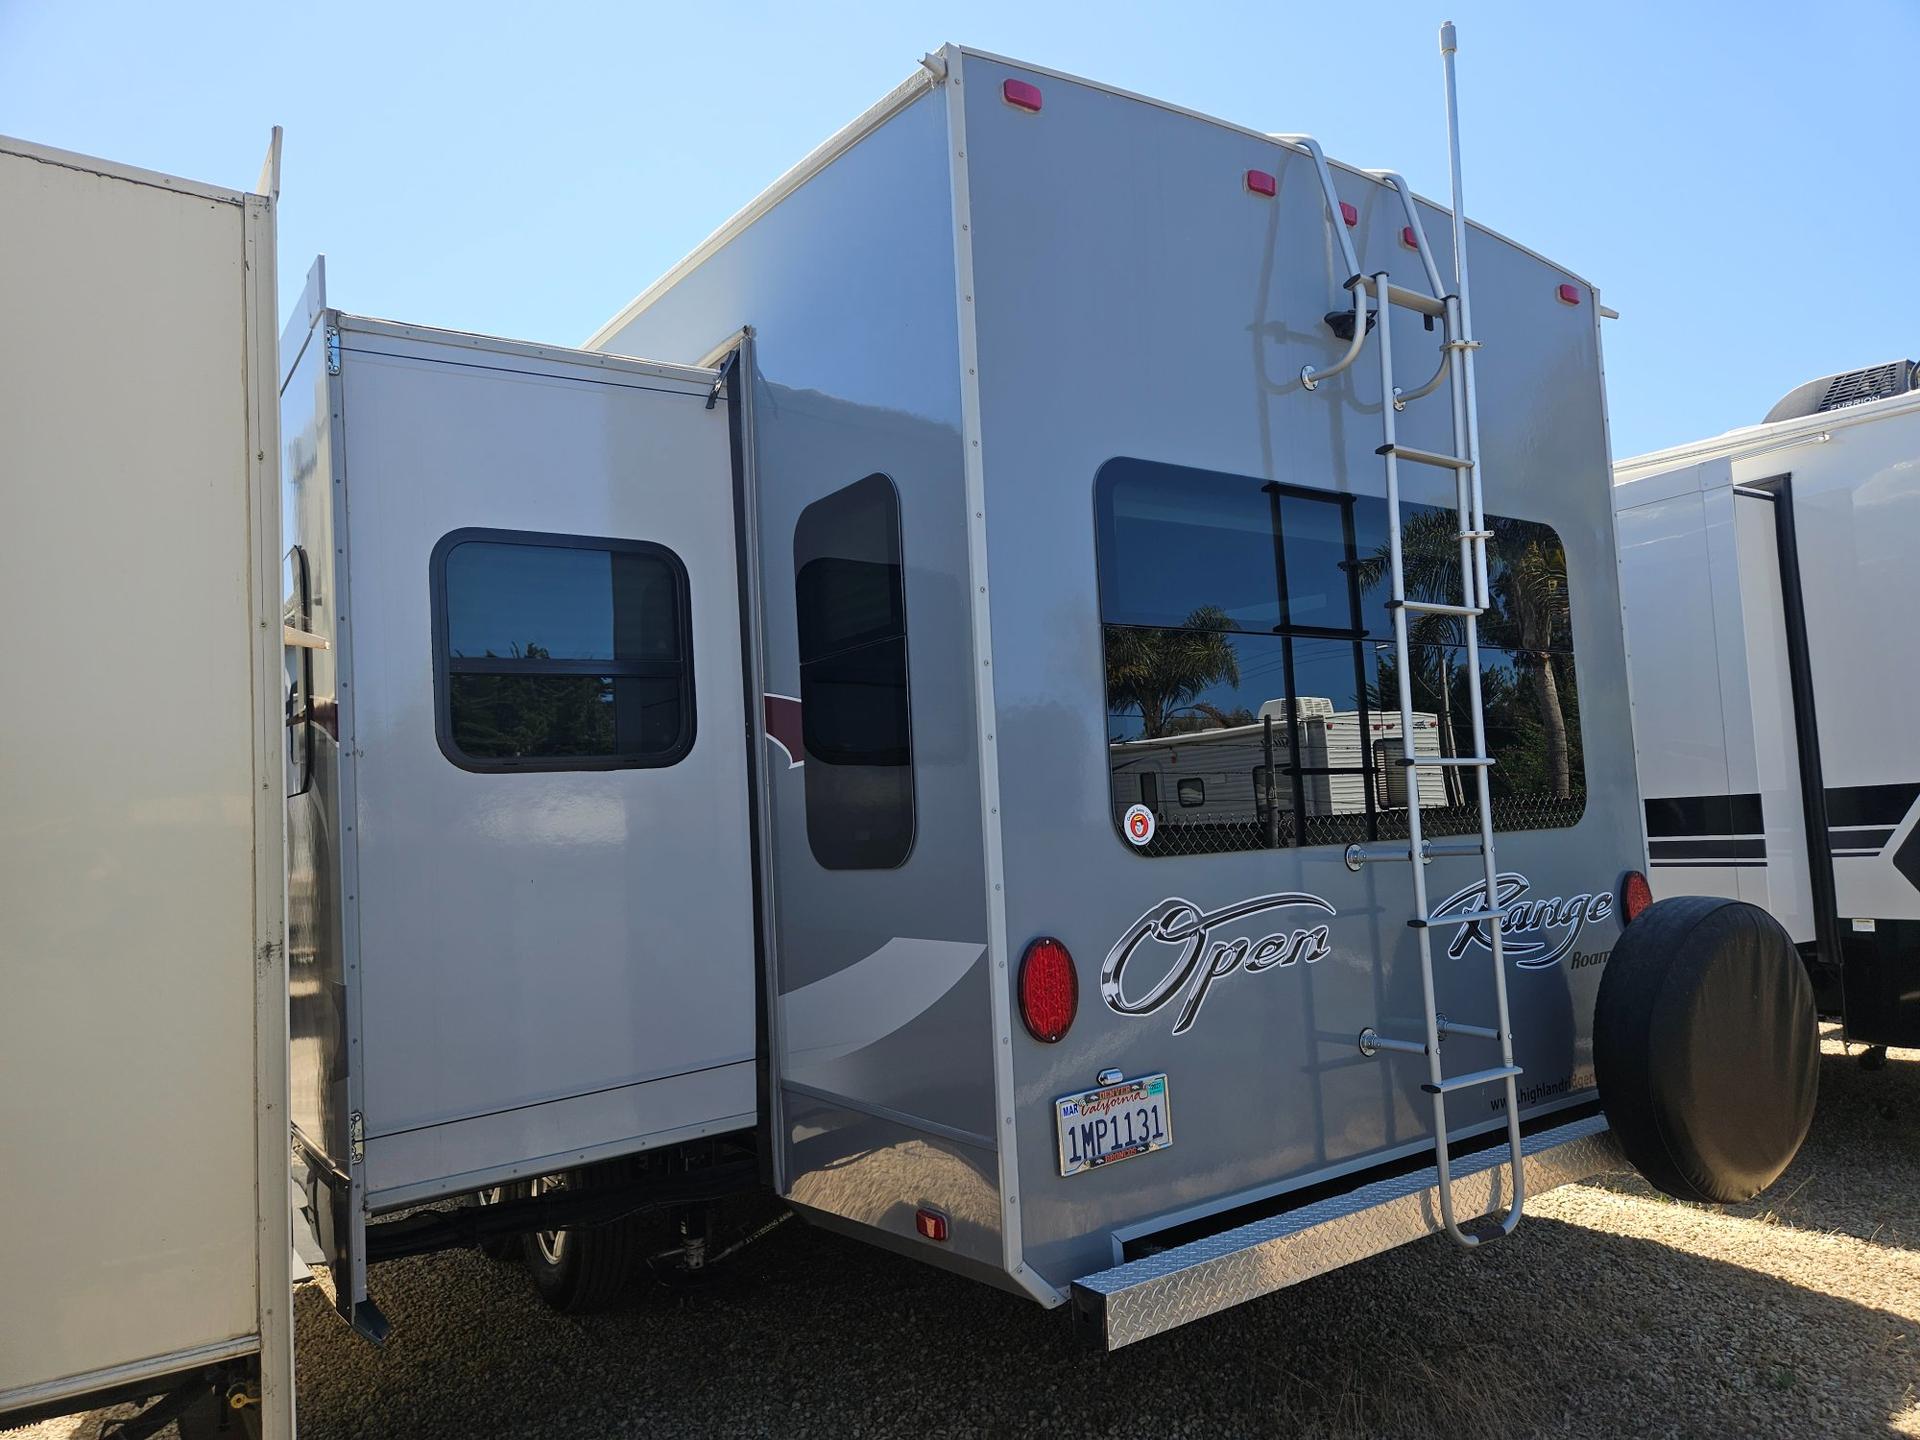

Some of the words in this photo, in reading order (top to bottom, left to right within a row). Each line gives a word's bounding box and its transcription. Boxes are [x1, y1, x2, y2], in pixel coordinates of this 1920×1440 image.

[1100, 891, 1337, 1036] Open
[1429, 872, 1613, 969] Range
[1099, 1086, 1132, 1099] DENVER
[1063, 1104, 1078, 1117] MAR
[1079, 1091, 1148, 1116] California
[1068, 1104, 1164, 1163] 1MP1131
[1104, 1148, 1137, 1162] BRONCOS
